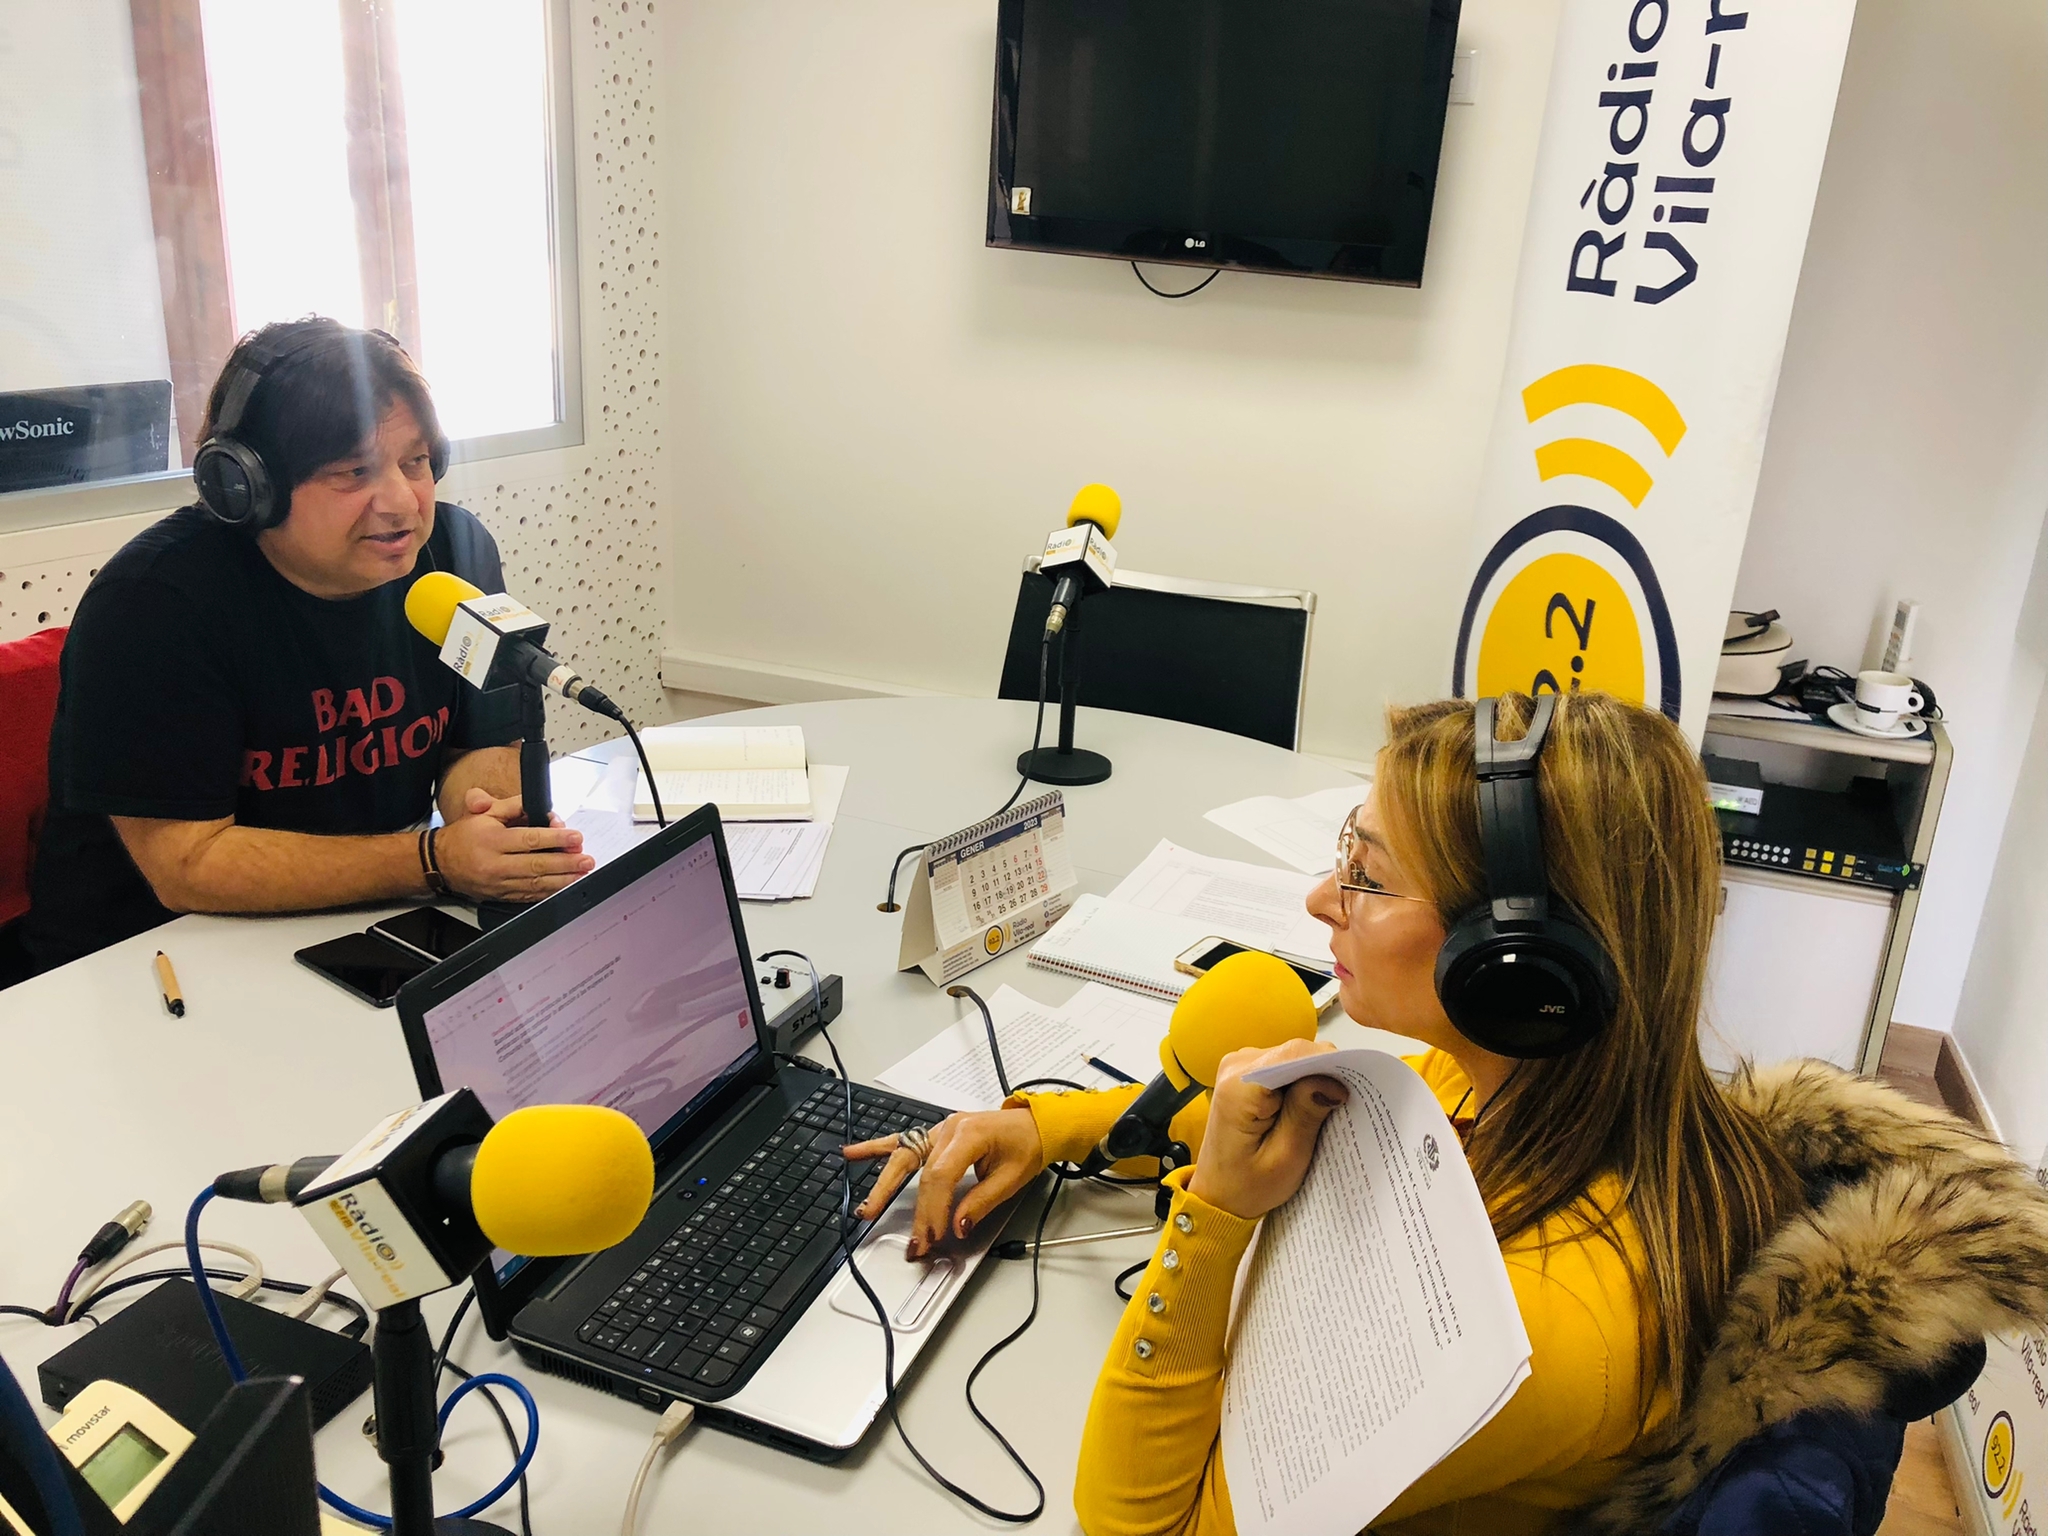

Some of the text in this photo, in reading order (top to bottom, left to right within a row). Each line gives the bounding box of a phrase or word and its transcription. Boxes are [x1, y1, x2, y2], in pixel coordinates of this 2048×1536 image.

[1567, 0, 1669, 297] Ràdio
[311, 675, 406, 733] BAD
[960, 841, 985, 858] GENER
[1023, 817, 1038, 830] 2023
[1539, 1004, 1565, 1014] JVC
[66, 1405, 111, 1444] movistar
